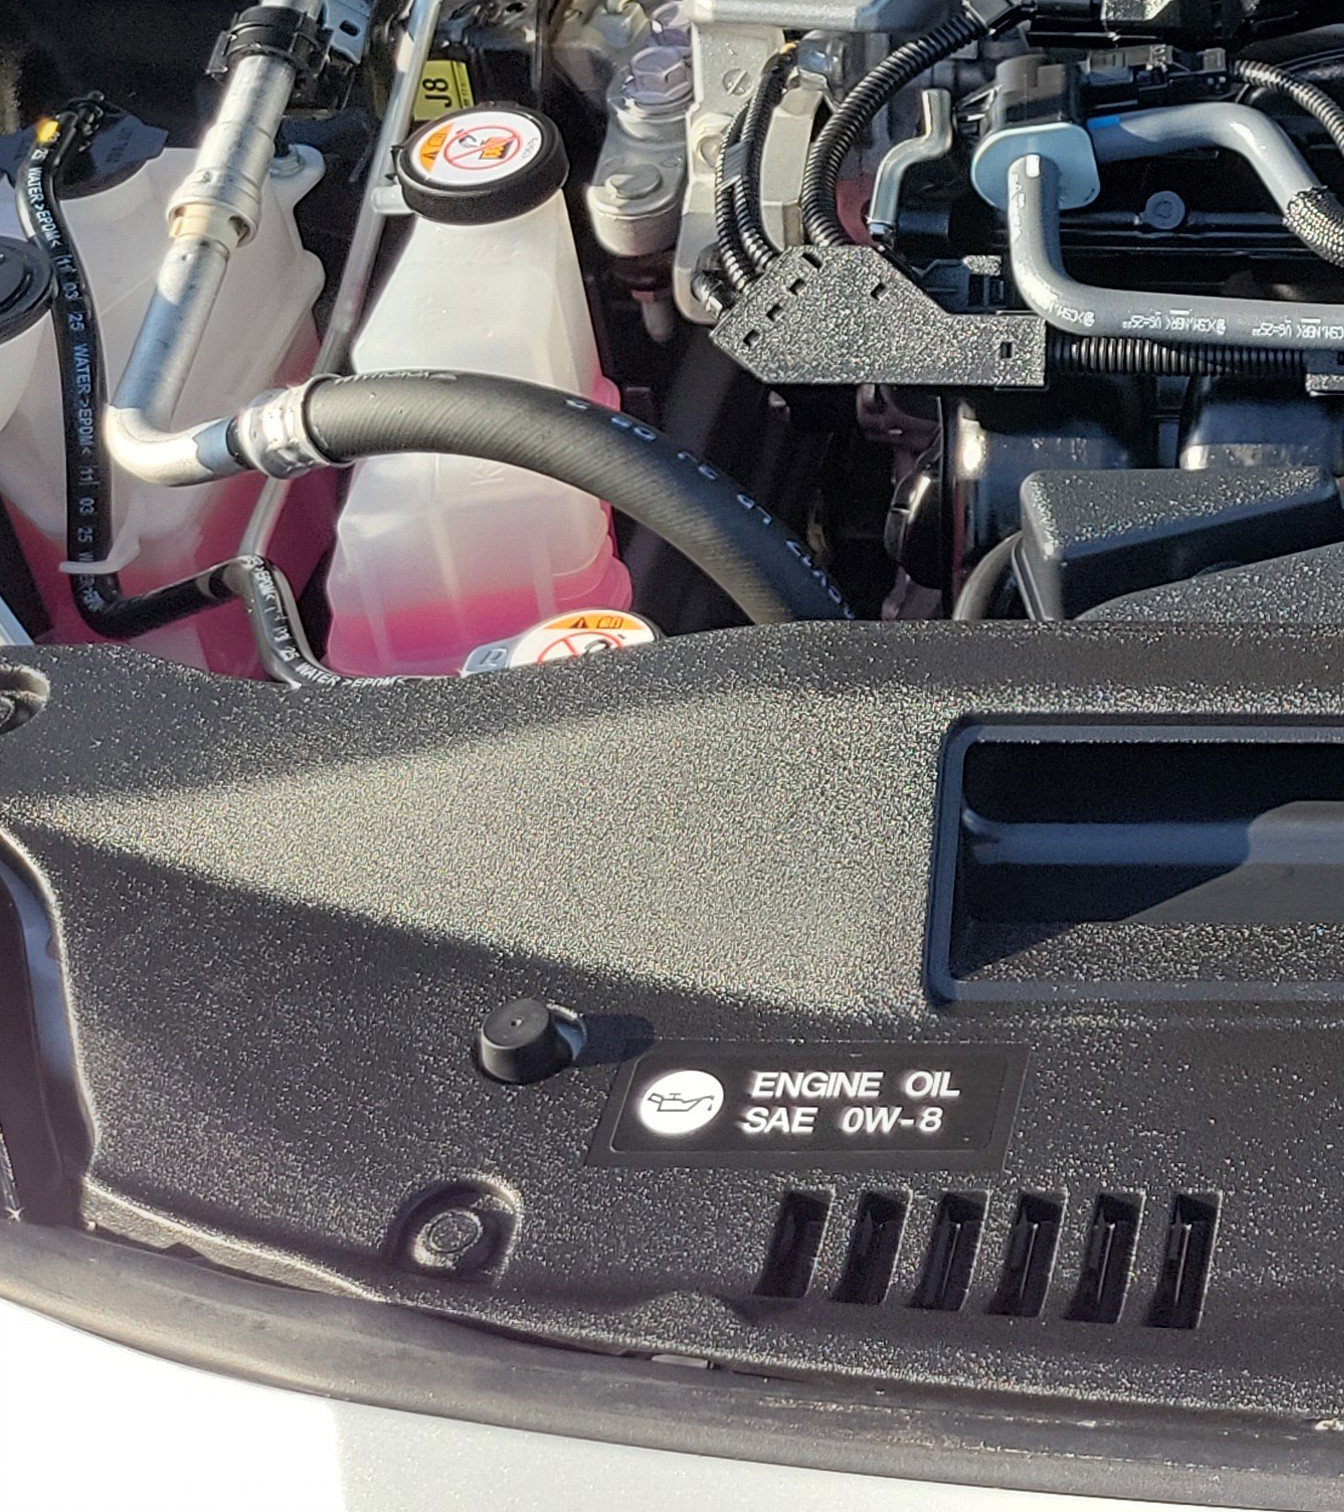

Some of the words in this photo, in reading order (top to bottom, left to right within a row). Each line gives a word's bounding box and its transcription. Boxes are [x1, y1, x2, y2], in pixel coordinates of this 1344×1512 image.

[422, 78, 452, 108] J8
[27, 167, 43, 208] WATER
[68, 312, 85, 331] 25
[72, 343, 92, 395] WATER
[78, 497, 95, 514] 03
[77, 526, 93, 543] 25
[296, 663, 342, 687] WATER
[751, 1071, 885, 1098] ENGINE
[905, 1071, 961, 1098] OIL
[740, 1106, 818, 1133] SAE
[842, 1106, 944, 1134] 0W-8
